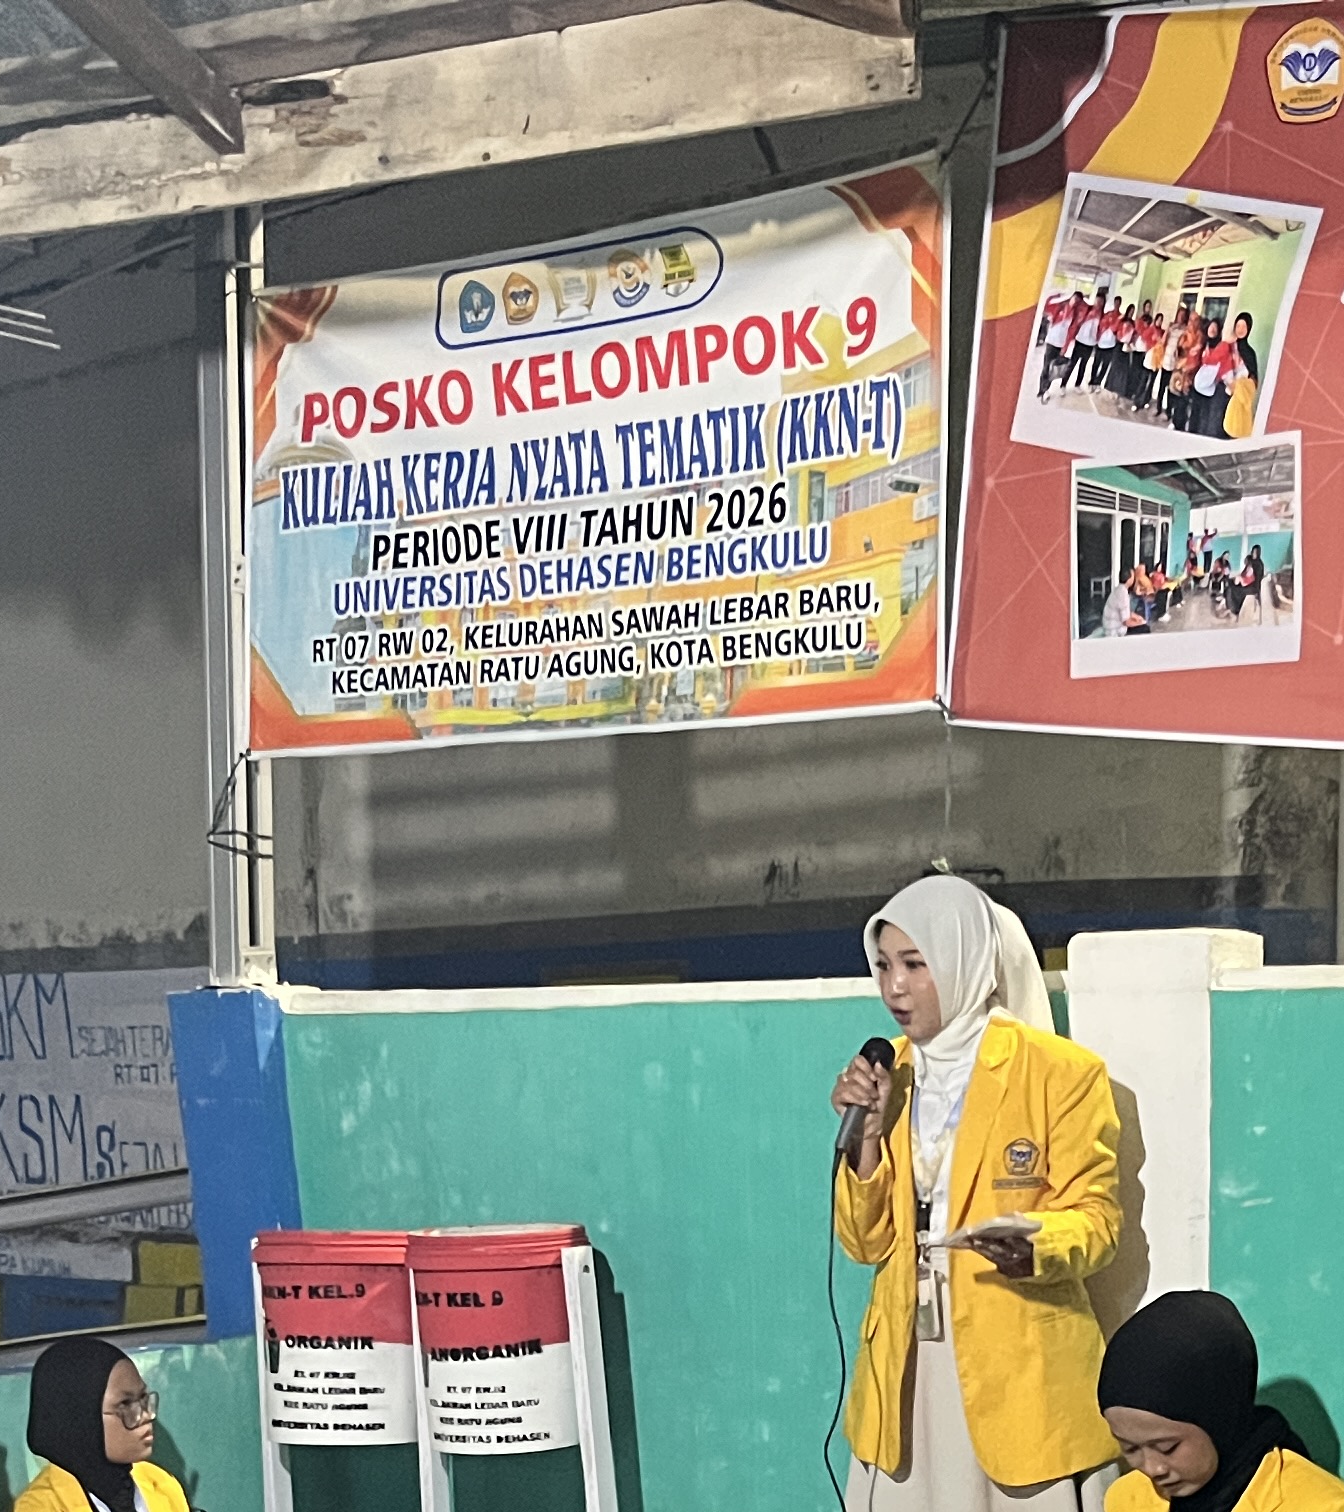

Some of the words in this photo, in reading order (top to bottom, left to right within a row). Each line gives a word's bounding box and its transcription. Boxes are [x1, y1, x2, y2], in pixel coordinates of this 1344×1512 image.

[301, 370, 473, 443] POSKO
[492, 306, 824, 417] KELOMPOK
[846, 297, 877, 357] 9
[281, 458, 396, 530] KULIAH
[401, 446, 496, 516] KERJA
[506, 430, 608, 503] NYATA
[615, 403, 766, 490] TEMATIK
[777, 377, 902, 476] (KKN-T)
[372, 520, 500, 571] PERIODE
[512, 514, 567, 555] VIII
[580, 496, 694, 547] TAHUN
[706, 482, 787, 534] 2026
[335, 566, 510, 616] UNIVERSITAS
[519, 551, 654, 598] DEHASEN
[666, 525, 828, 582] BENGKULU
[313, 638, 336, 663] RT
[344, 635, 369, 661] 07
[378, 631, 413, 658] RW
[422, 628, 455, 656] 02,
[465, 613, 603, 651] KELURAHAN
[612, 602, 699, 636] SAWAH
[710, 592, 789, 626] LEBAR
[799, 582, 879, 616] BARU,
[332, 660, 471, 695] KECAMATAN
[480, 655, 540, 684] RATU
[547, 646, 641, 678] AGUNG,
[650, 638, 714, 670] KOTA
[722, 622, 863, 662] BENGKULU
[285, 1335, 375, 1350] ORGANIK
[431, 1338, 544, 1362] ANORGANIK
